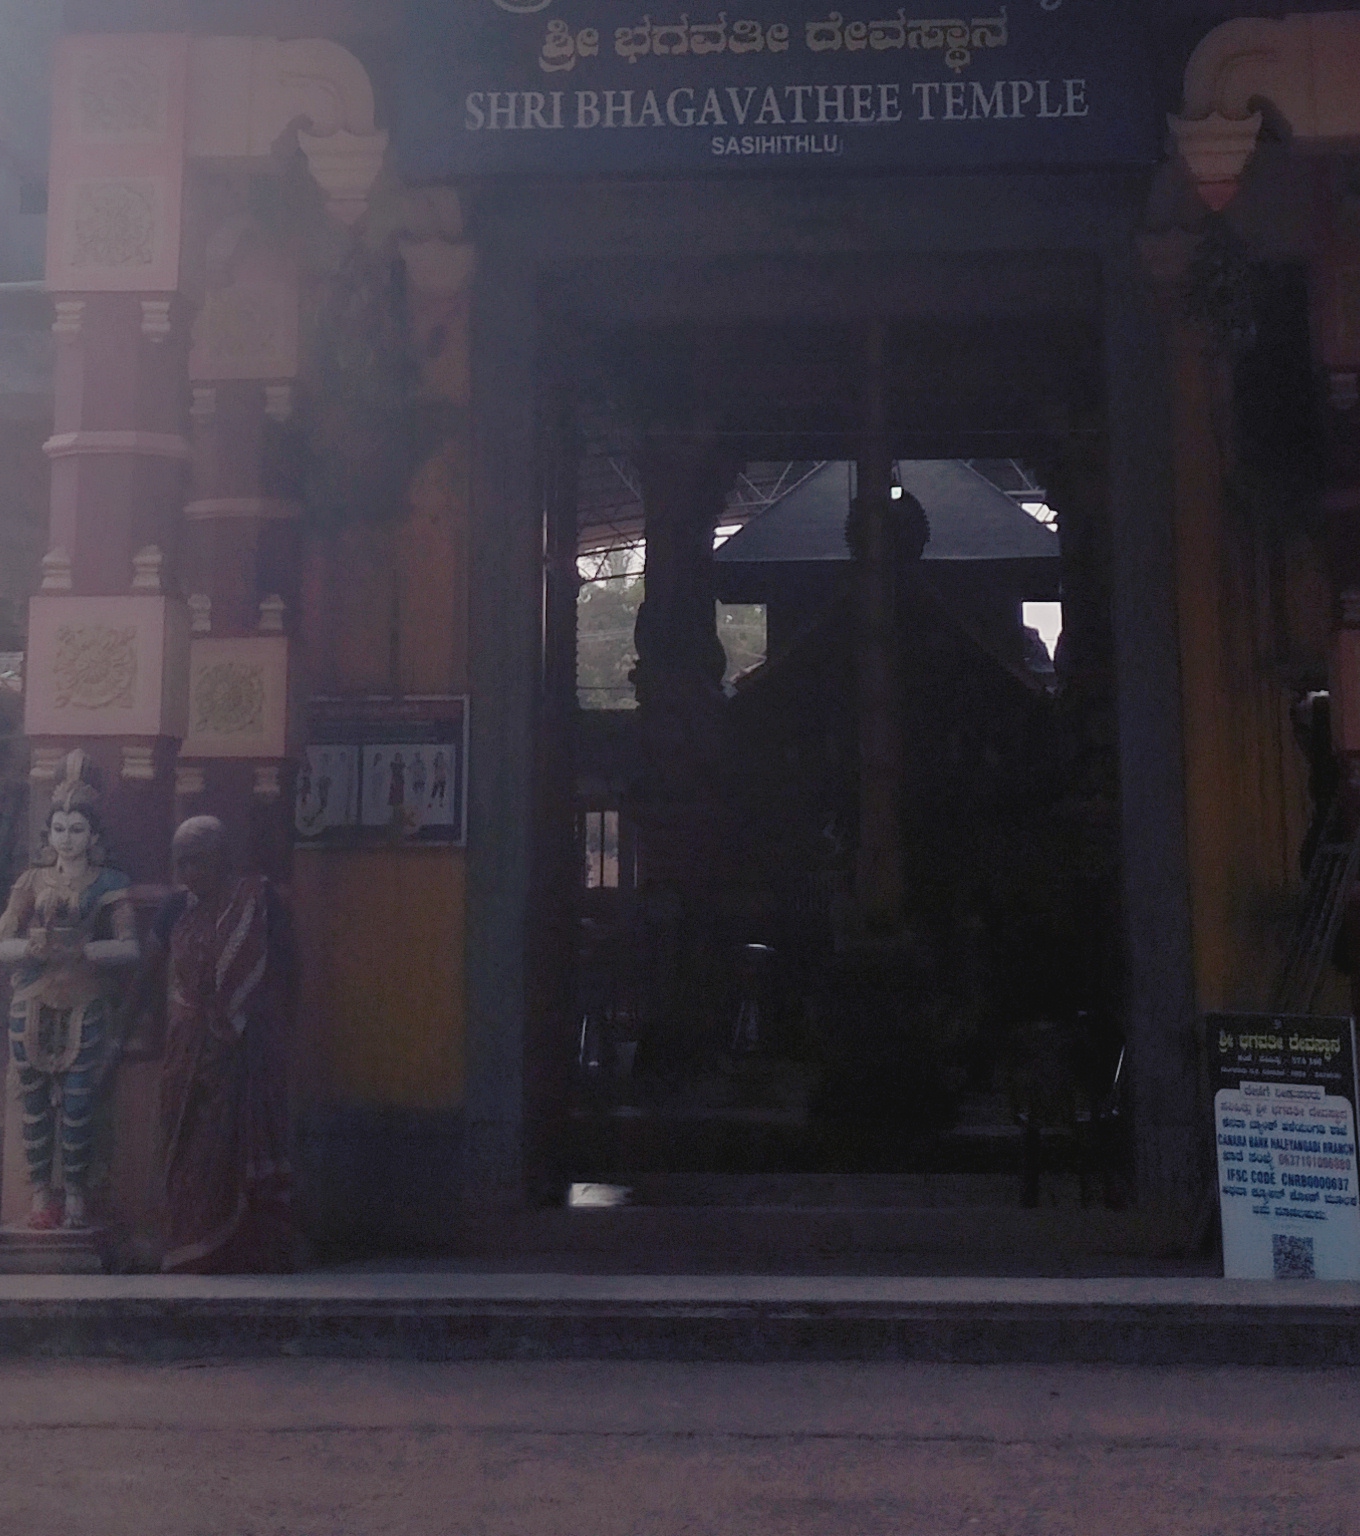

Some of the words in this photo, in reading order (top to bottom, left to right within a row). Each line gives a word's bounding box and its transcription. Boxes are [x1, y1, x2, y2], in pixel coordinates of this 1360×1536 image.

[540, 19, 599, 72] ಶ್ರೀ
[615, 13, 789, 65] ಭಗವತೀ
[805, 6, 1008, 73] ದೇವಸ್ಥಾನ
[465, 90, 564, 130] SHRI
[573, 84, 902, 127] BHAGAVATHEE
[912, 79, 1089, 121] TEMPLE
[711, 135, 837, 155] SASIHITHLU
[1227, 1169, 1248, 1182] IFSC
[1251, 1170, 1276, 1185] CODE
